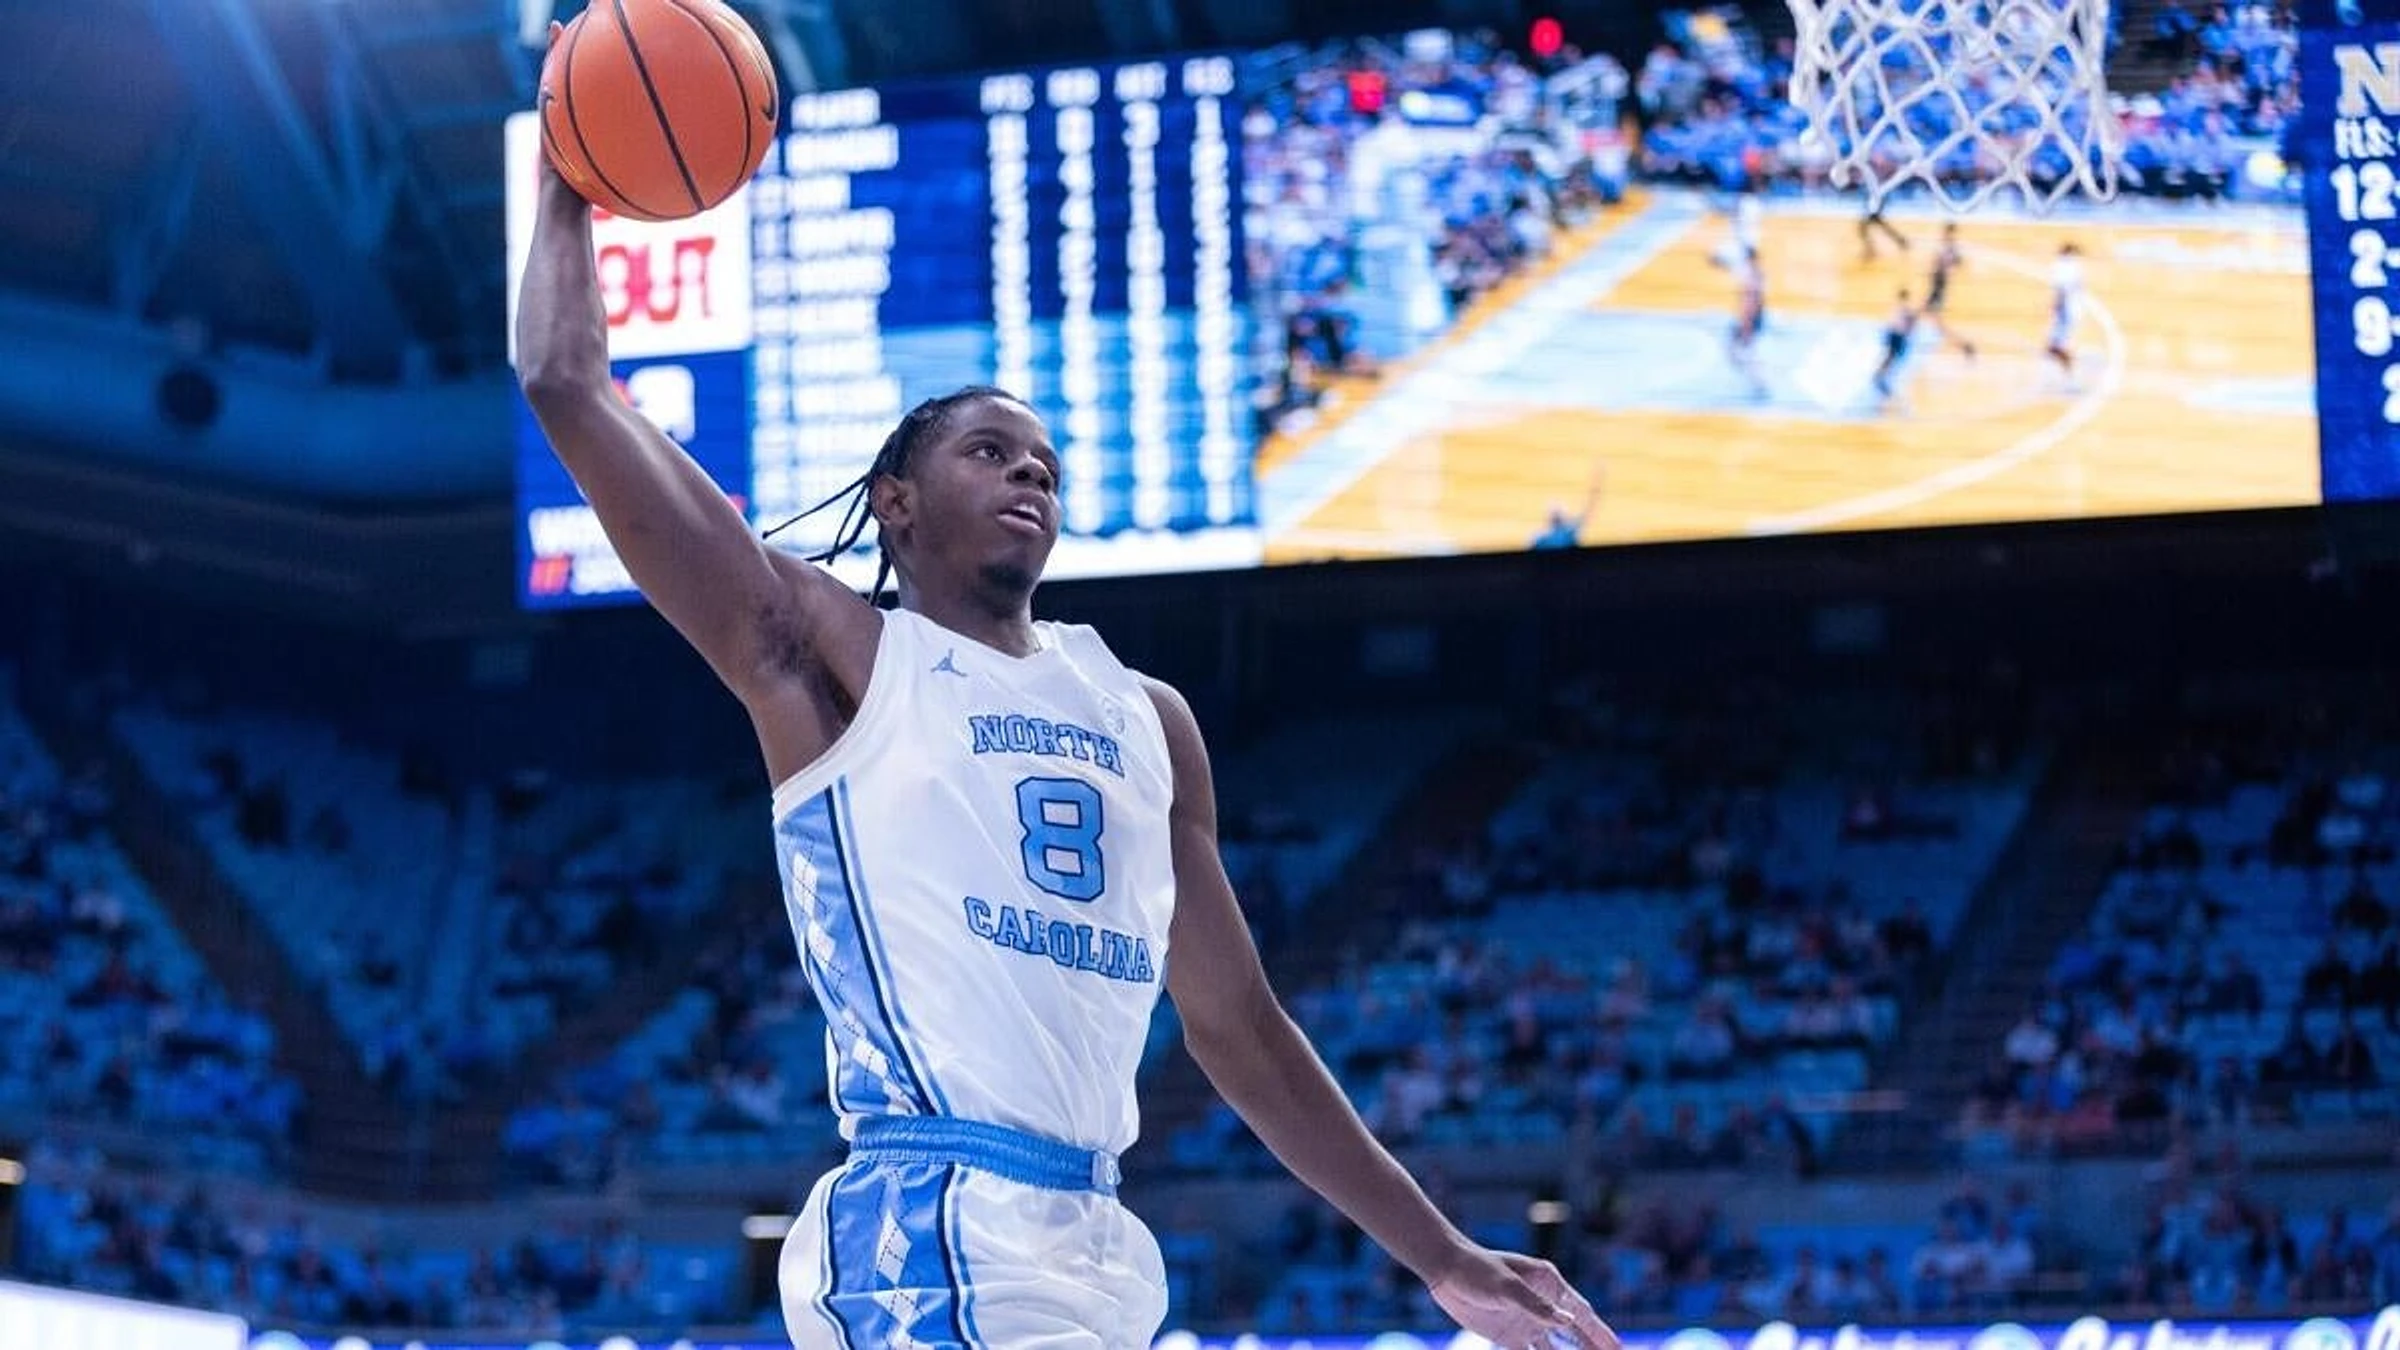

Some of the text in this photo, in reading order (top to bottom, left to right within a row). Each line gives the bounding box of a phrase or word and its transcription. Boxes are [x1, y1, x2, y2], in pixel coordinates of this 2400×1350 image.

[968, 714, 1125, 778] NORTH
[1015, 775, 1105, 902] 8
[963, 896, 1154, 982] CAROLINA
